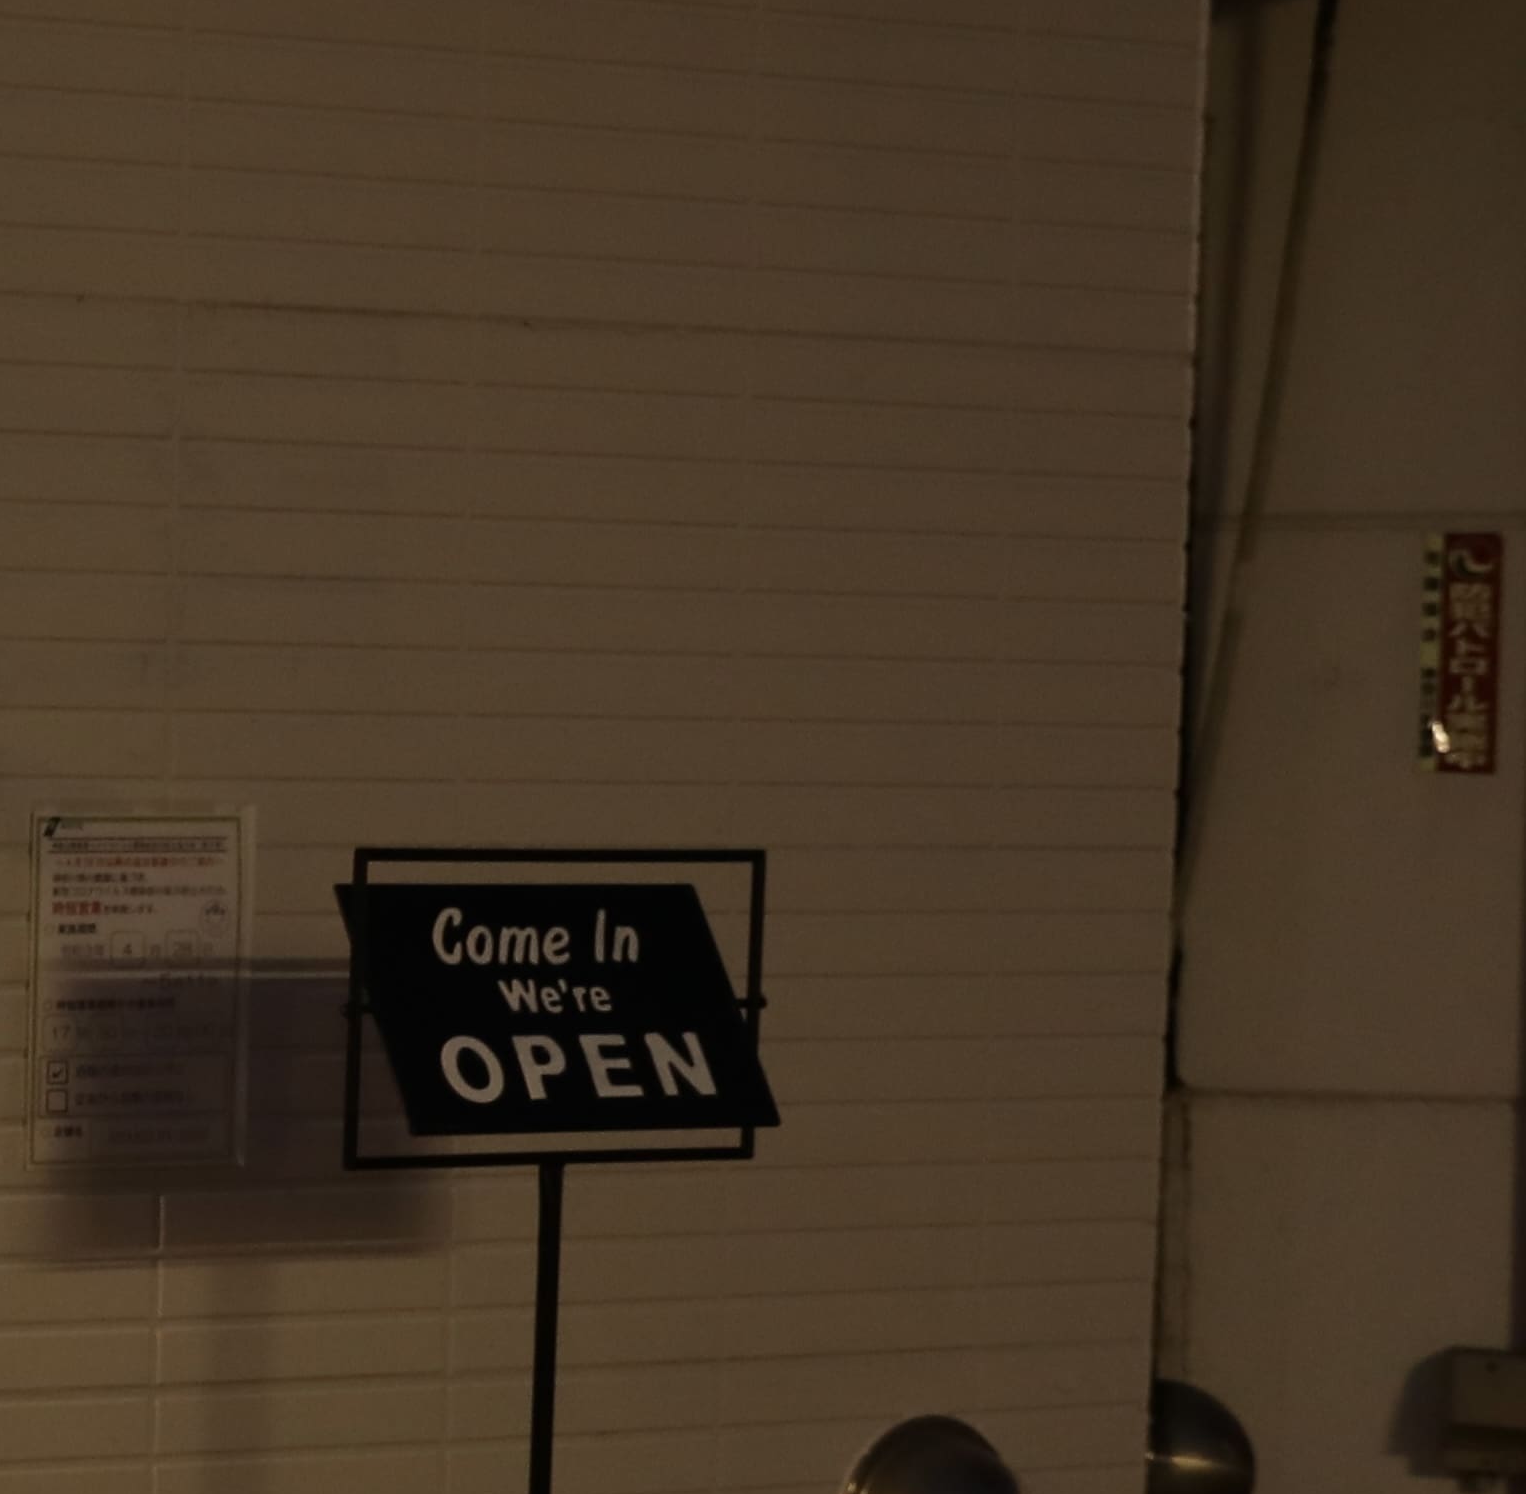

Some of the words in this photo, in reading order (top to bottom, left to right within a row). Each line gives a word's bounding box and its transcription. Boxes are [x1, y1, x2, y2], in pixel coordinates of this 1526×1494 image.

[431, 906, 571, 967] Come
[593, 907, 641, 964] In
[496, 978, 614, 1015] We're
[439, 1031, 718, 1105] OPEN
